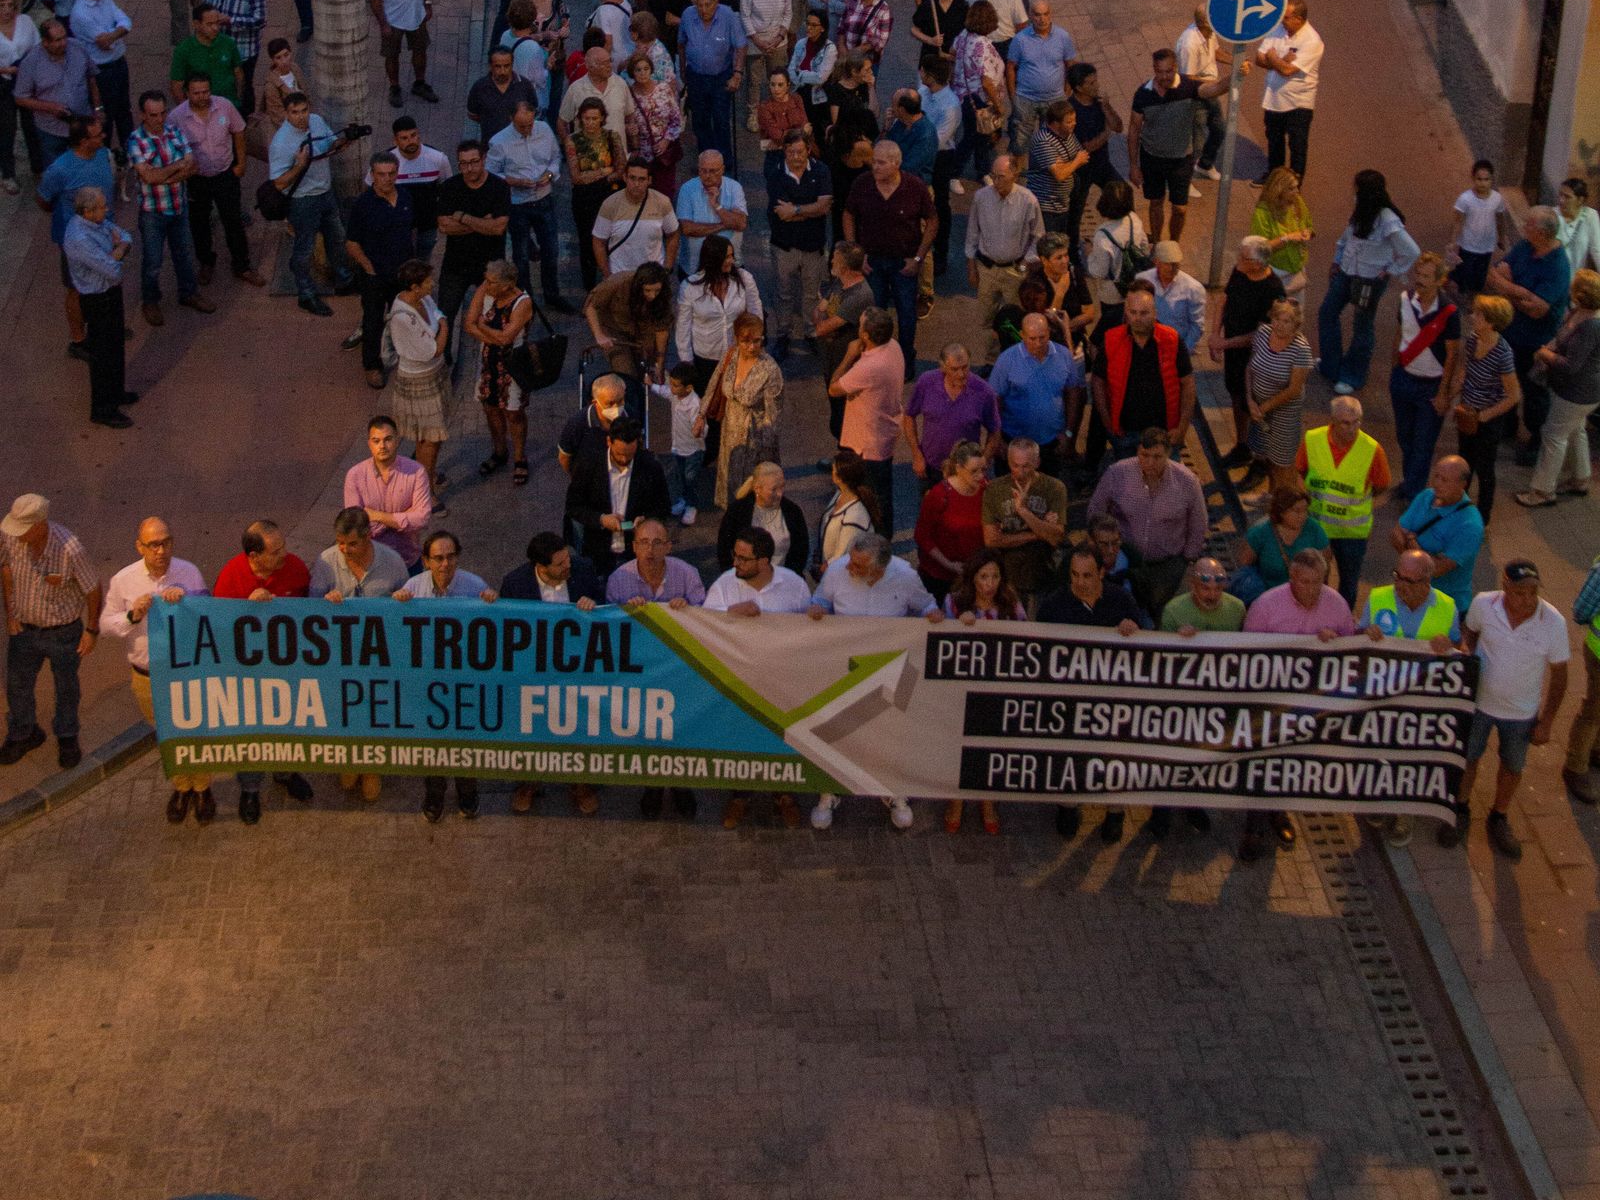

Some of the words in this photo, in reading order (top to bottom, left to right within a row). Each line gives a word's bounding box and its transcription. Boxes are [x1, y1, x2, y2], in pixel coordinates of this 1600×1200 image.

[168, 614, 221, 669] LA
[233, 614, 391, 667] COSTA
[402, 615, 645, 674] TROPICAL
[936, 639, 987, 677] PER
[995, 640, 1042, 679] LES
[1049, 645, 1313, 690] CANALITZACIONS
[1318, 655, 1359, 694] DE
[1365, 656, 1472, 697] RULES.
[169, 676, 328, 730] UNIDA
[340, 679, 415, 730] PEL
[426, 681, 504, 732] SEU
[519, 685, 677, 741] FUTUR
[1002, 699, 1067, 733] PELS
[1073, 702, 1227, 747] ESPIGONS
[1231, 708, 1254, 749] A
[1261, 710, 1318, 748] LES
[1321, 710, 1464, 750] PLATGES.
[175, 742, 306, 766] PLATAFORMA
[311, 743, 348, 765] PER
[352, 744, 387, 766] LES
[391, 747, 586, 774] INFRAESTRUCTURES
[589, 753, 614, 775] DE
[618, 754, 643, 777] LA
[647, 754, 709, 779] COSTA
[712, 757, 807, 784] TROPICAL
[987, 752, 1038, 790] PER
[1045, 755, 1077, 791] LA
[1246, 756, 1456, 803] FERROVIÀRIA.
